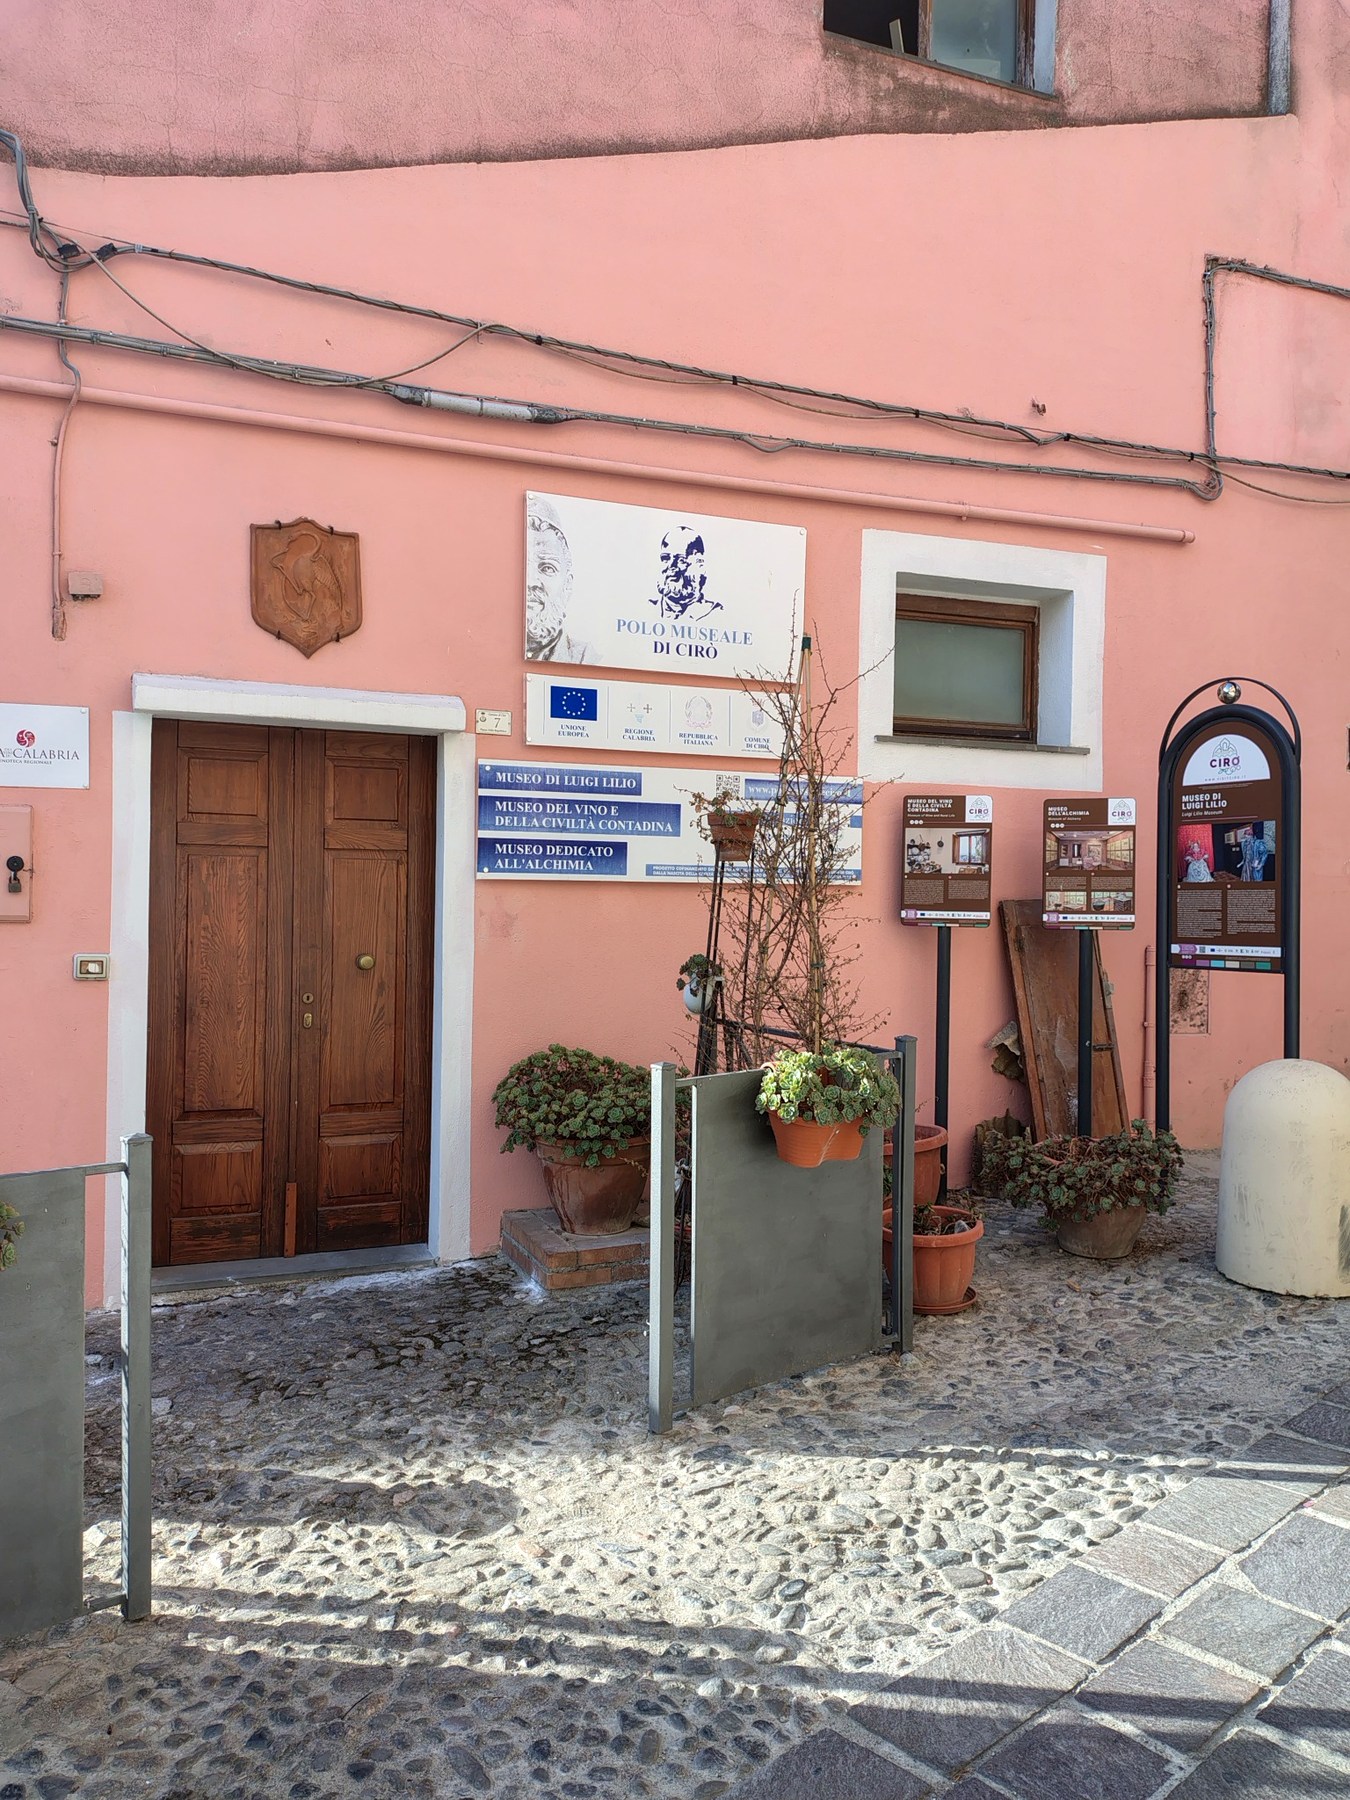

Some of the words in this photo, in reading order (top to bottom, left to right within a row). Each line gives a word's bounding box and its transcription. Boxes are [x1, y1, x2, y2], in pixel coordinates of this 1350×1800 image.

[616, 618, 666, 637] POLO
[670, 624, 753, 646] MUSEALE
[653, 641, 670, 655] DI
[675, 643, 718, 660] CIRÒ
[494, 717, 501, 728] 7
[622, 734, 656, 742] CALABRIA
[679, 732, 718, 740] REPUBBLICA
[744, 736, 771, 744] COMUNE
[12, 747, 80, 760] CALABRIA
[495, 772, 542, 785] MUSEO
[546, 773, 560, 785] DI
[564, 774, 599, 788] LUIGI
[603, 776, 637, 789] LILIO
[1182, 794, 1210, 802] MUSEO
[495, 801, 543, 814] MUSEO
[546, 803, 573, 814] DEL
[575, 804, 608, 816] VINO
[610, 805, 619, 816] E
[1182, 801, 1203, 810] LUIGI
[1205, 800, 1228, 808] LILIO
[495, 816, 542, 828] DELLA
[542, 816, 595, 830] CIVILTÀ
[598, 819, 673, 832] CONTADINA
[495, 843, 543, 855] MUSEO
[546, 845, 614, 857] DEDICATO
[494, 858, 594, 871] ALL'ALCHIMIA
